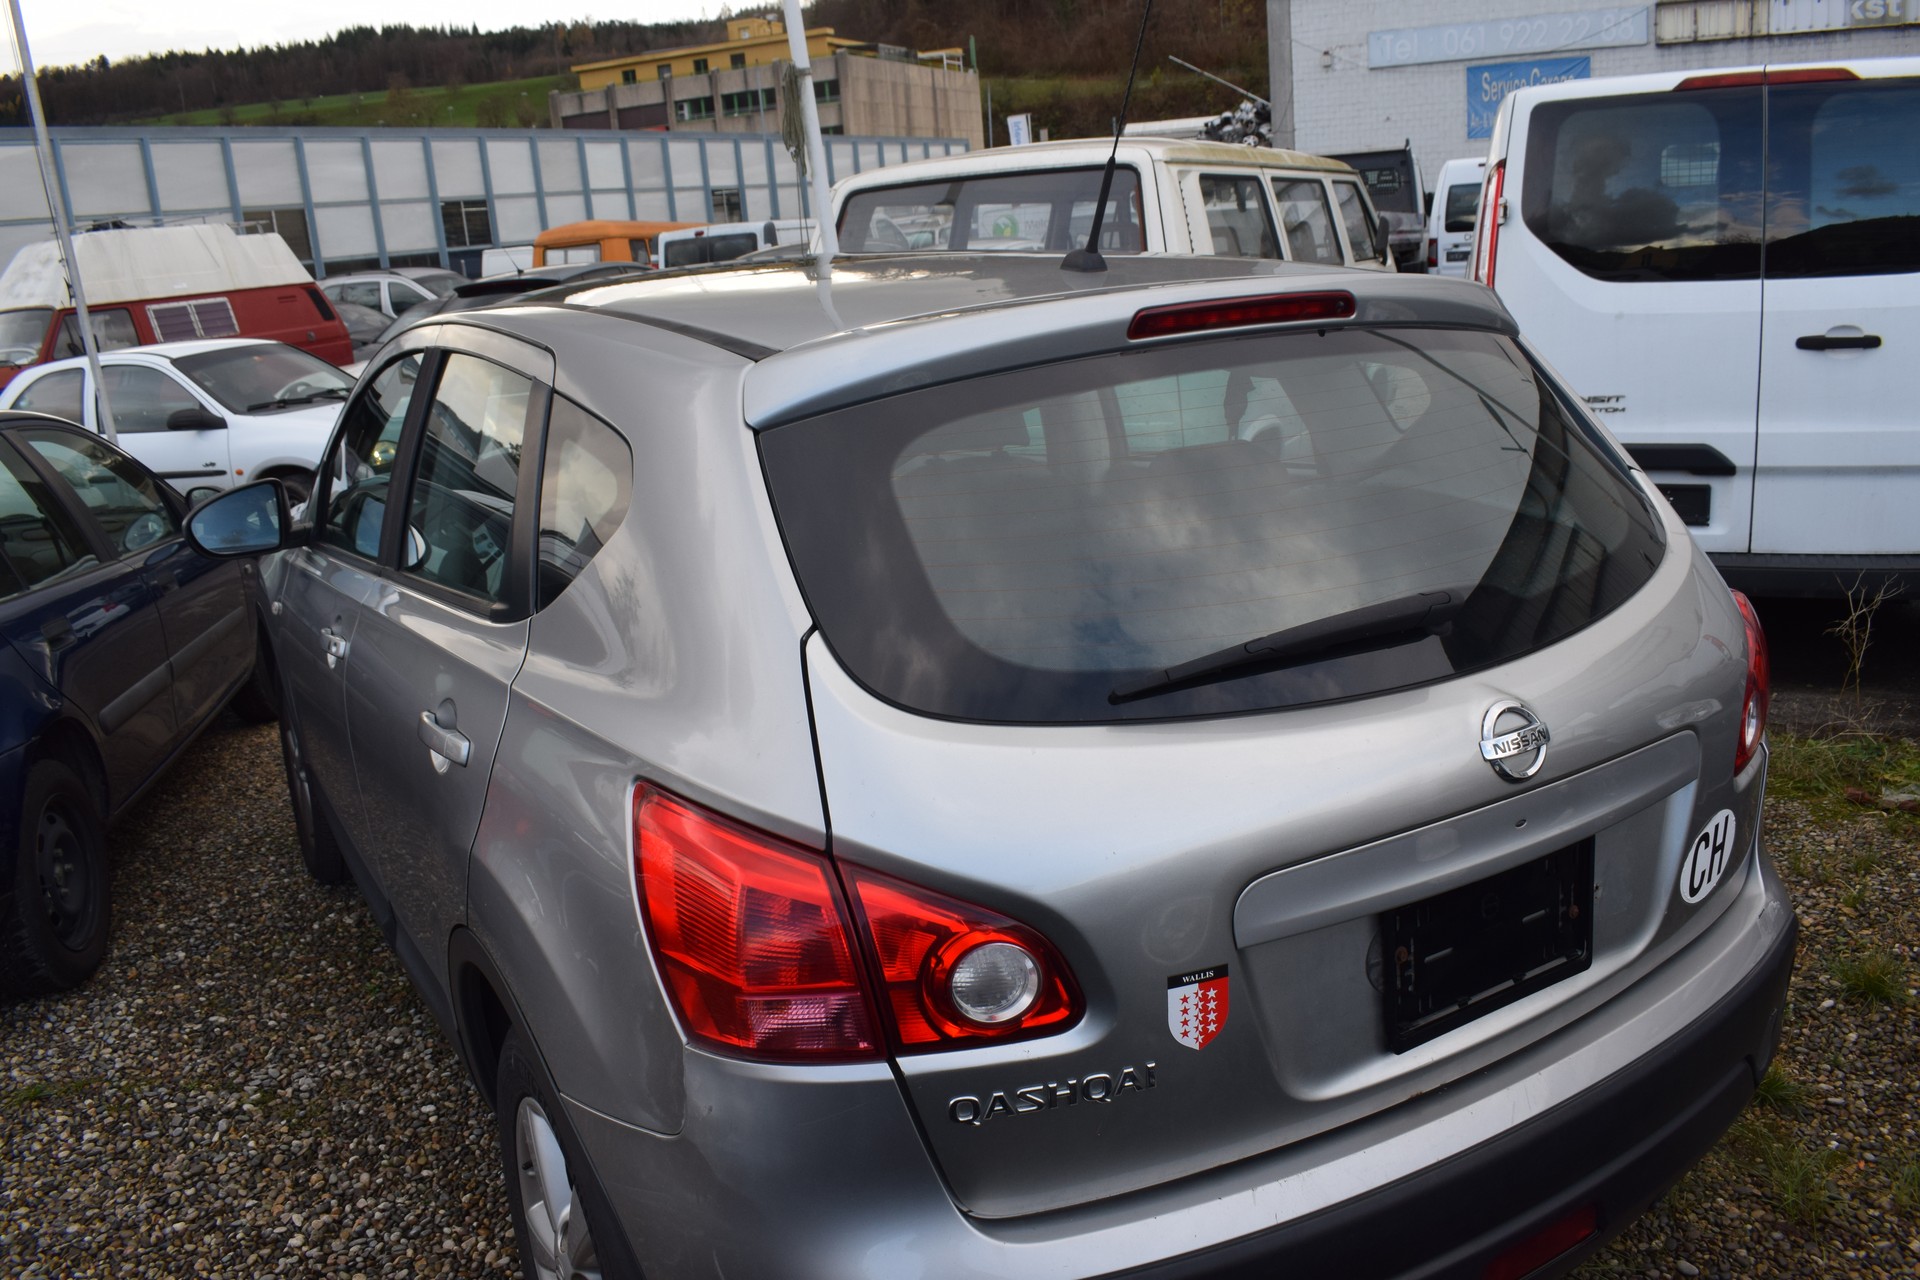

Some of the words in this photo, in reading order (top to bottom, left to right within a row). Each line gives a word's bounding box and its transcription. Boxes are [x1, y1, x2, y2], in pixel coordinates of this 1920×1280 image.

[1443, 26, 1487, 55] 061
[1500, 19, 1548, 49] 922
[1559, 16, 1590, 43] 22
[1581, 395, 1626, 403] NSIT
[1493, 727, 1547, 756] NISSAN
[1689, 814, 1729, 898] CH
[1182, 970, 1214, 983] WALLIS
[949, 1061, 1157, 1126] QASHQAI
